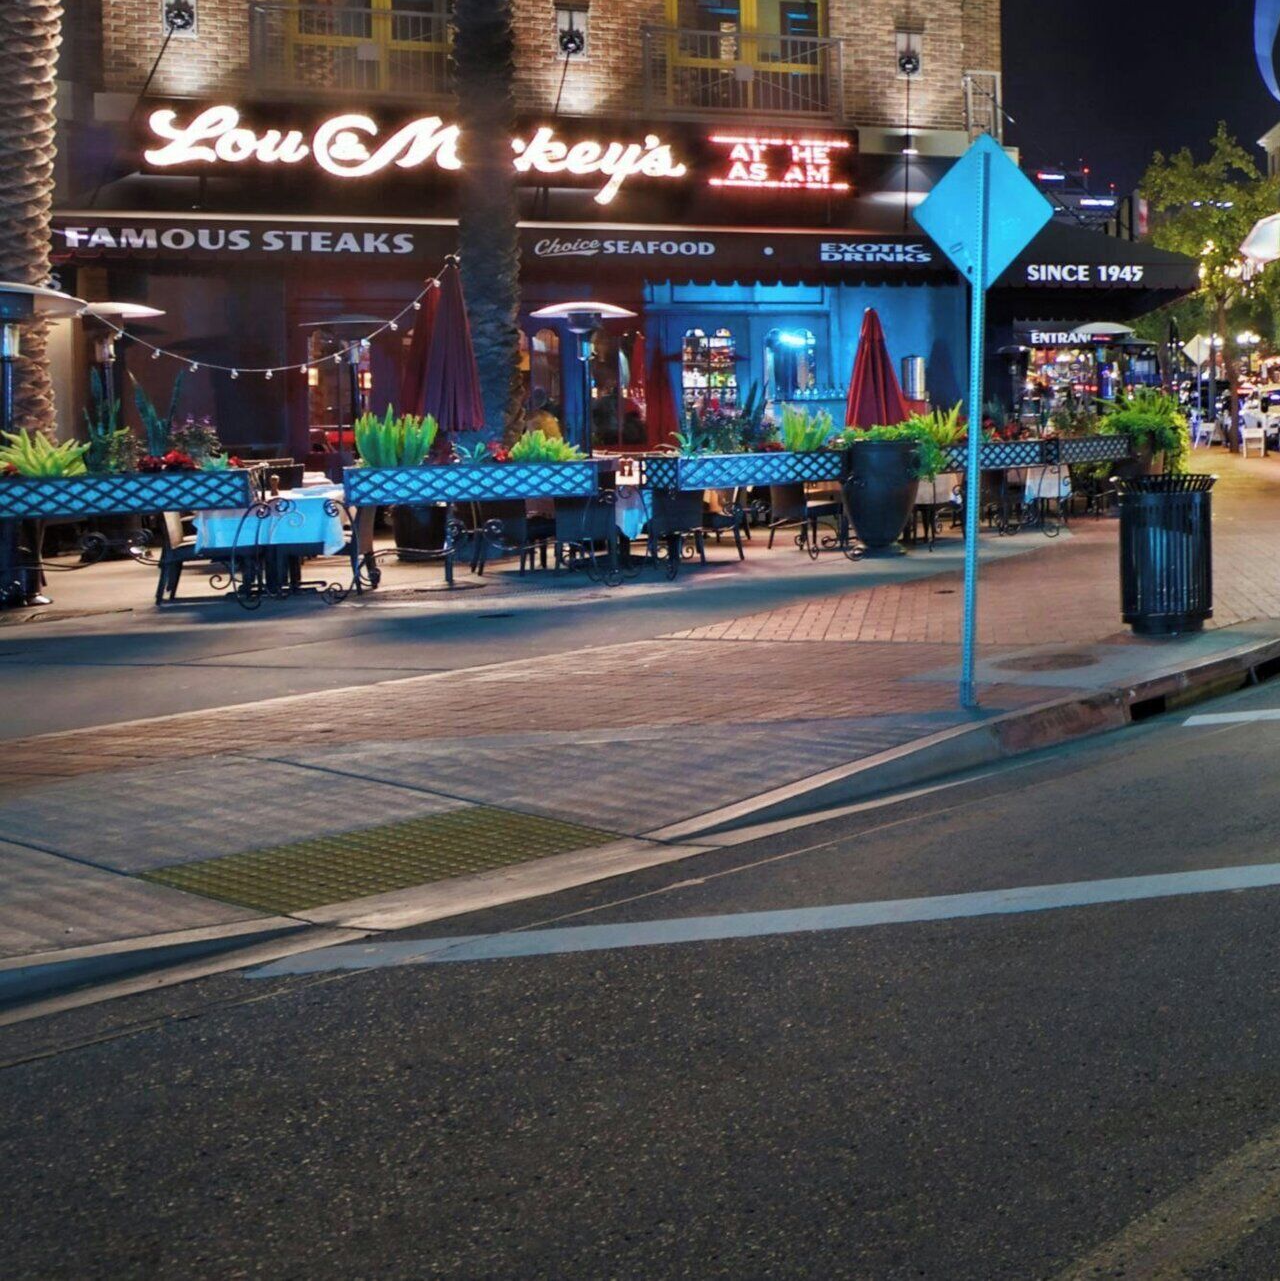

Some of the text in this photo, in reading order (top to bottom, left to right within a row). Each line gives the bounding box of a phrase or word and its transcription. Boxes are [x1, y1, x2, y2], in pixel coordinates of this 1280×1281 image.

[144, 105, 309, 166] Lou
[64, 226, 415, 254] FAMOUS STEAKS
[534, 238, 715, 258] Choice SEAFOOD
[821, 243, 923, 253] EXOTIC
[821, 253, 932, 263] DRINKS
[1027, 264, 1143, 282] SINCE 1945
[1031, 331, 1091, 344] ENTRAN
